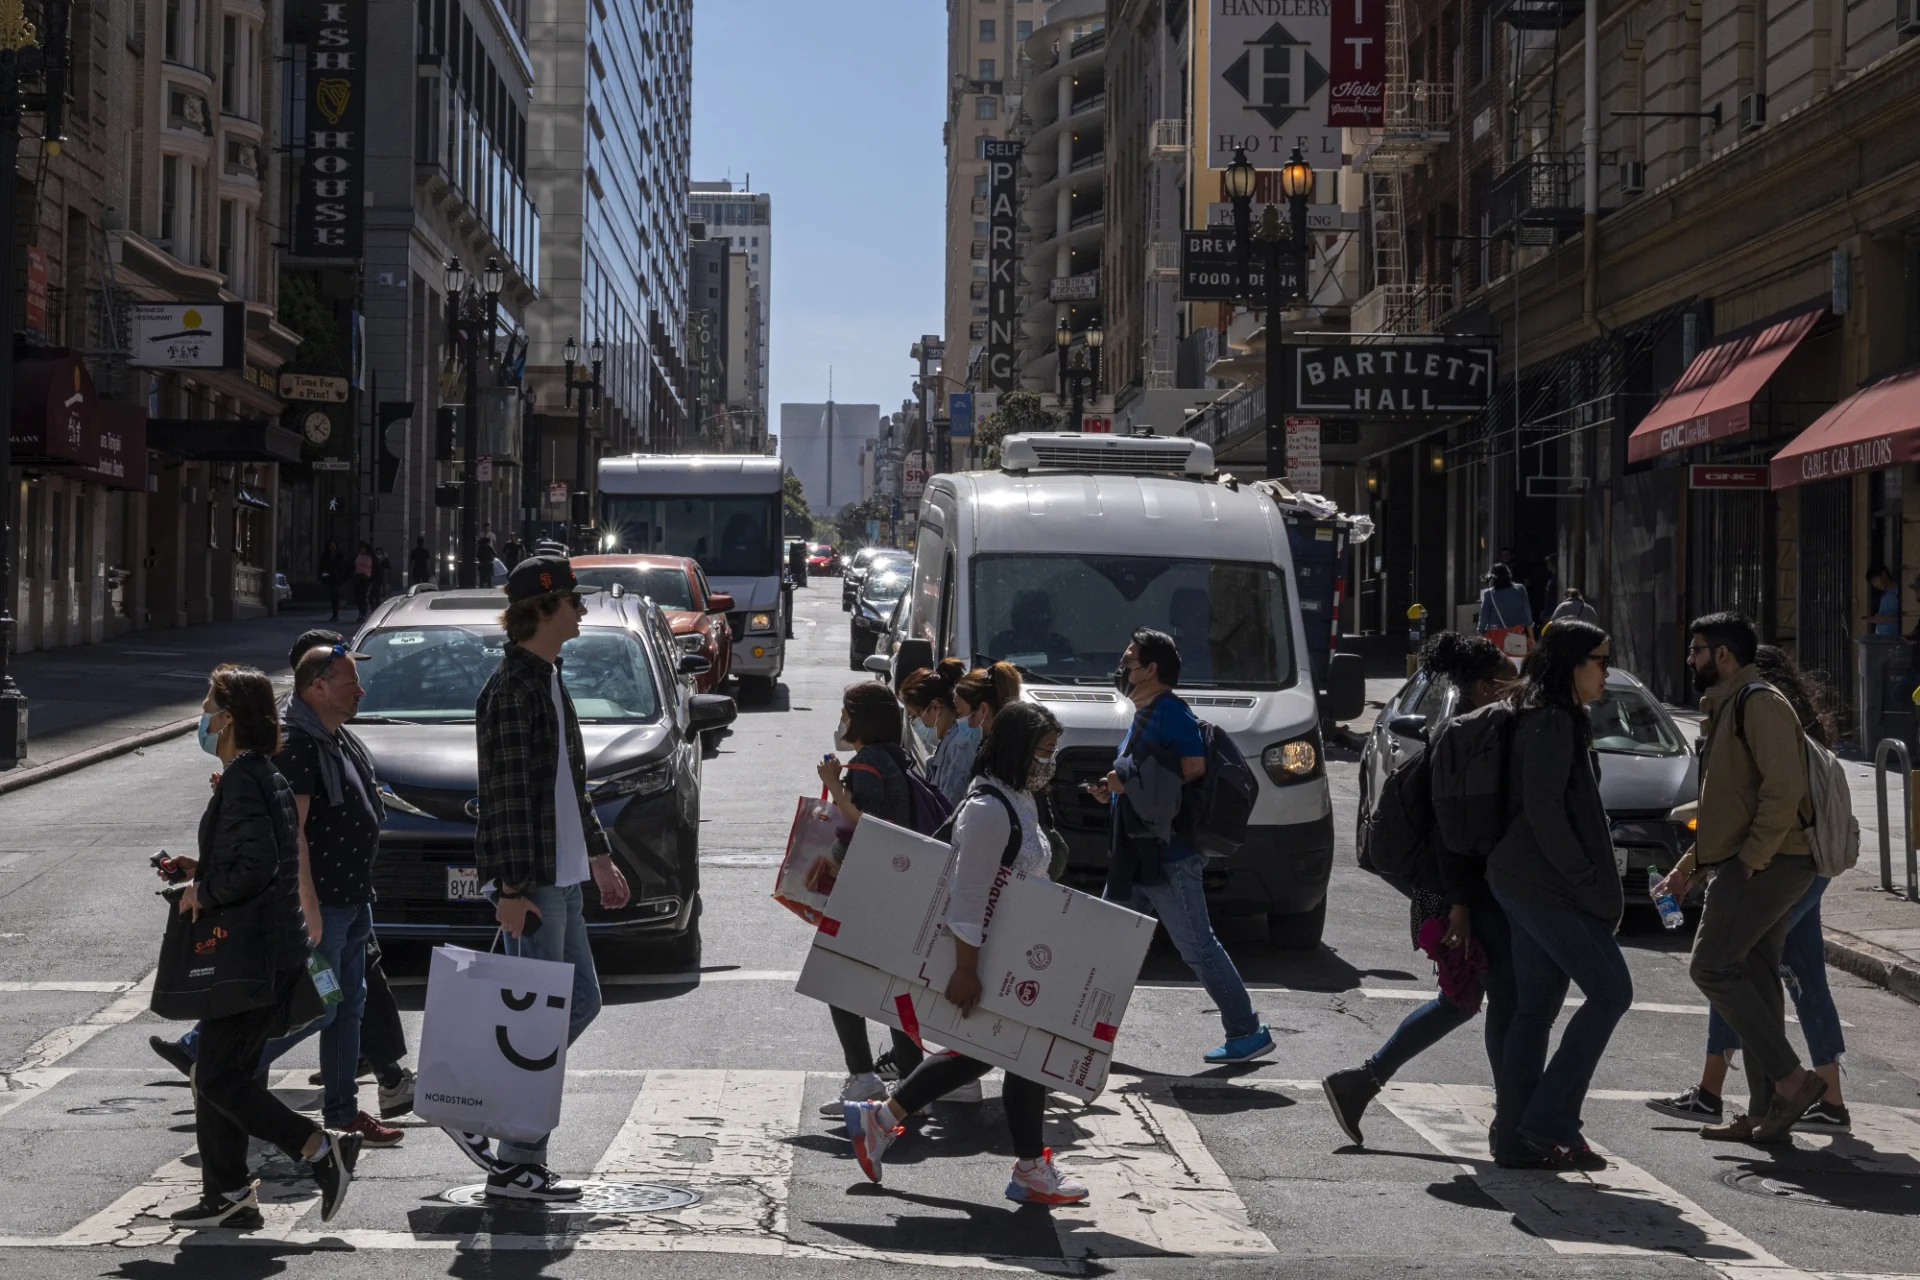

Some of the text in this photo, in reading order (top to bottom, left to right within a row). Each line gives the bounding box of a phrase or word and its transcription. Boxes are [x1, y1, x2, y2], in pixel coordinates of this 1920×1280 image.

[1220, 0, 1331, 16] HANDLERY
[1332, 80, 1382, 97] Hotel
[986, 143, 1020, 156] SELF
[1218, 134, 1334, 154] HOTEL
[308, 131, 354, 246] HOUSE
[991, 162, 1014, 378] PARKING
[1189, 272, 1230, 285] FOOD
[1056, 285, 1090, 294] IMPORTS
[700, 314, 711, 436] COLUMBIA
[1306, 351, 1485, 386] BARTLETT
[294, 376, 334, 388] Time For
[306, 389, 329, 399] Pint!
[1354, 388, 1436, 410] HALL
[1286, 425, 1297, 433] NO
[1661, 424, 1684, 450] GNC
[1287, 458, 1297, 468] NO
[1802, 438, 1892, 479] CABLE CAR TAILORS
[1020, 983, 1033, 1001] LBC
[1072, 967, 1096, 1026] HANDLE WITH CARE
[1067, 1059, 1080, 1083] LARGE
[425, 1093, 483, 1107] NORDSTROM
